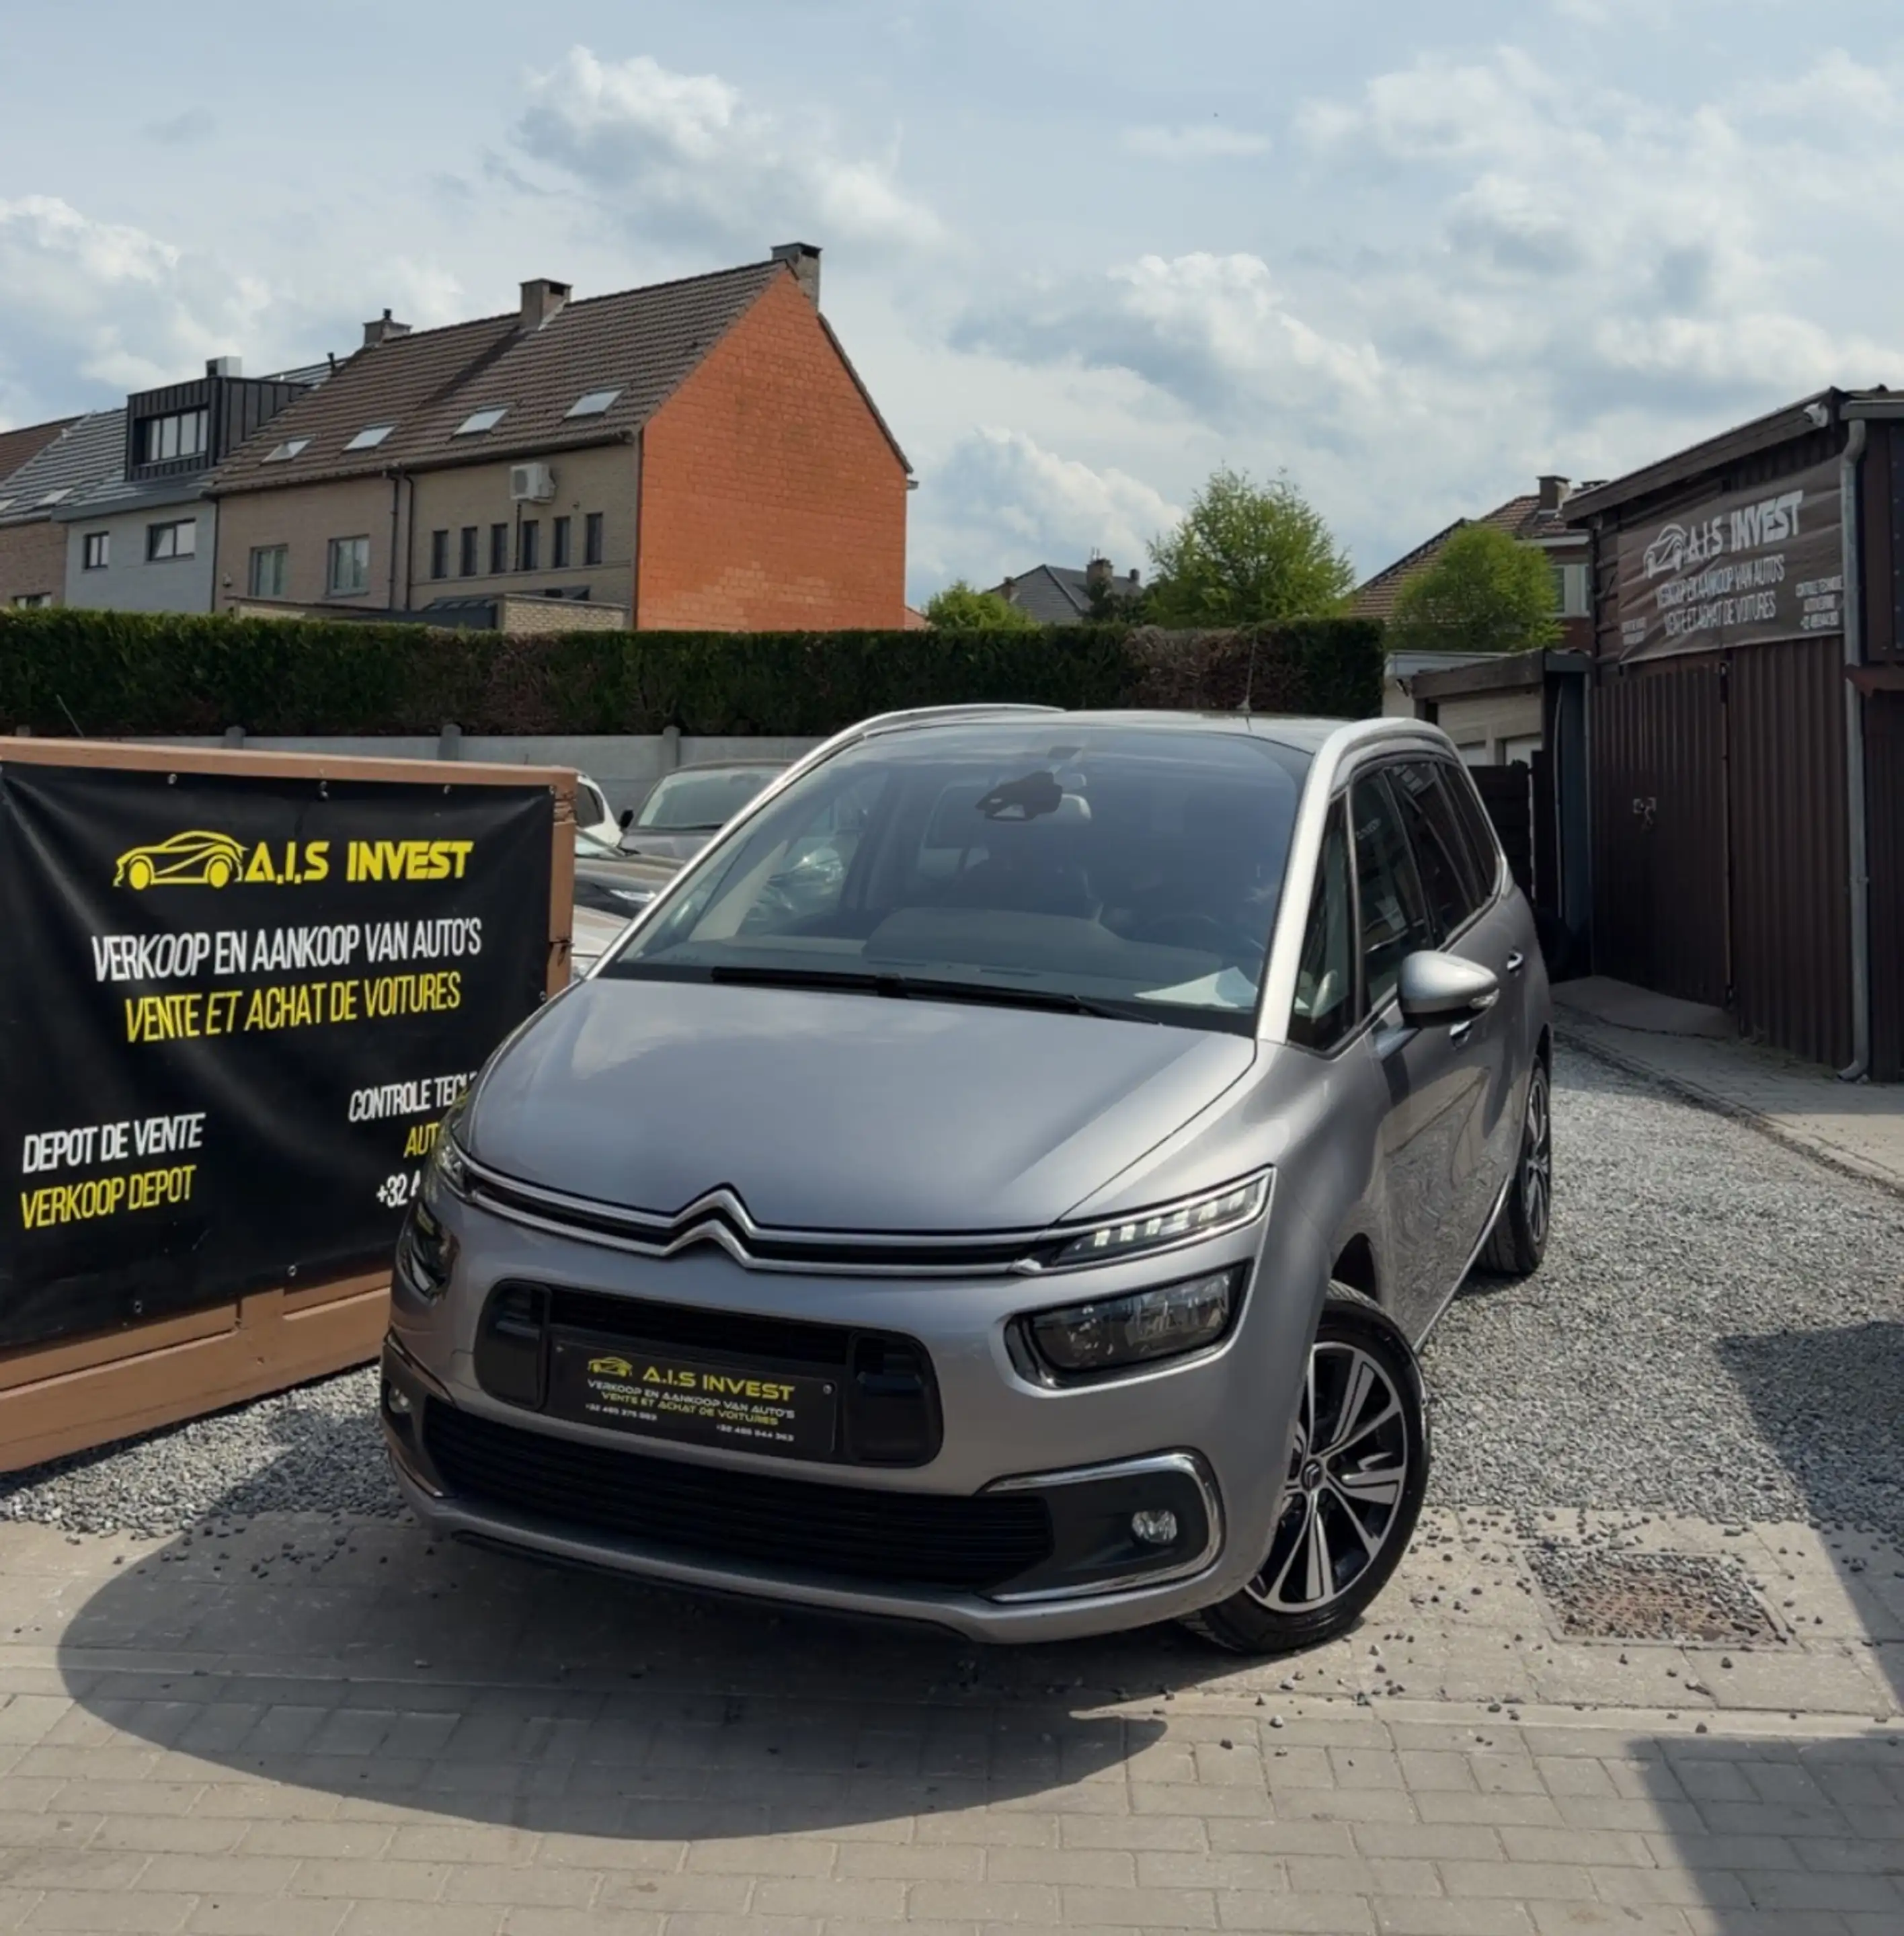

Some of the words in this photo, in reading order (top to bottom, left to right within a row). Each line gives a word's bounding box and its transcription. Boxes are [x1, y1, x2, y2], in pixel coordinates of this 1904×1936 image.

[1731, 489, 1803, 553] INVEST
[244, 842, 329, 885] A.I.S
[347, 841, 474, 881] INVEST
[91, 932, 210, 982] VERKOOP
[214, 930, 248, 975] EN
[251, 924, 360, 972] AANKOOP
[364, 921, 409, 963] VAN
[411, 917, 482, 959] AUTO'S
[125, 993, 202, 1043] VENTE
[206, 990, 243, 1035] ET
[243, 982, 327, 1031] ACHAT
[330, 979, 360, 1022] DE
[364, 971, 461, 1018] VOITURES
[348, 1079, 432, 1123] CONTROLE
[434, 1071, 477, 1108] TEC
[22, 1126, 98, 1174] DEPOT
[100, 1121, 130, 1162] DE
[134, 1112, 206, 1157] VENTE
[403, 1121, 441, 1158] AUT
[21, 1177, 125, 1229] VERKOOP
[128, 1164, 197, 1210] DEPOT
[376, 1173, 408, 1208] +32
[587, 1378, 643, 1395] VERKOOP
[644, 1388, 660, 1399] EN
[662, 1392, 721, 1407] AANKOOP
[723, 1400, 748, 1412] VAN
[643, 1365, 697, 1387] A.I.S
[703, 1374, 795, 1402] INVEST
[601, 1391, 638, 1405] VENTE
[641, 1397, 656, 1407] ET
[699, 1407, 715, 1417] DE
[718, 1409, 779, 1425] VOITURES
